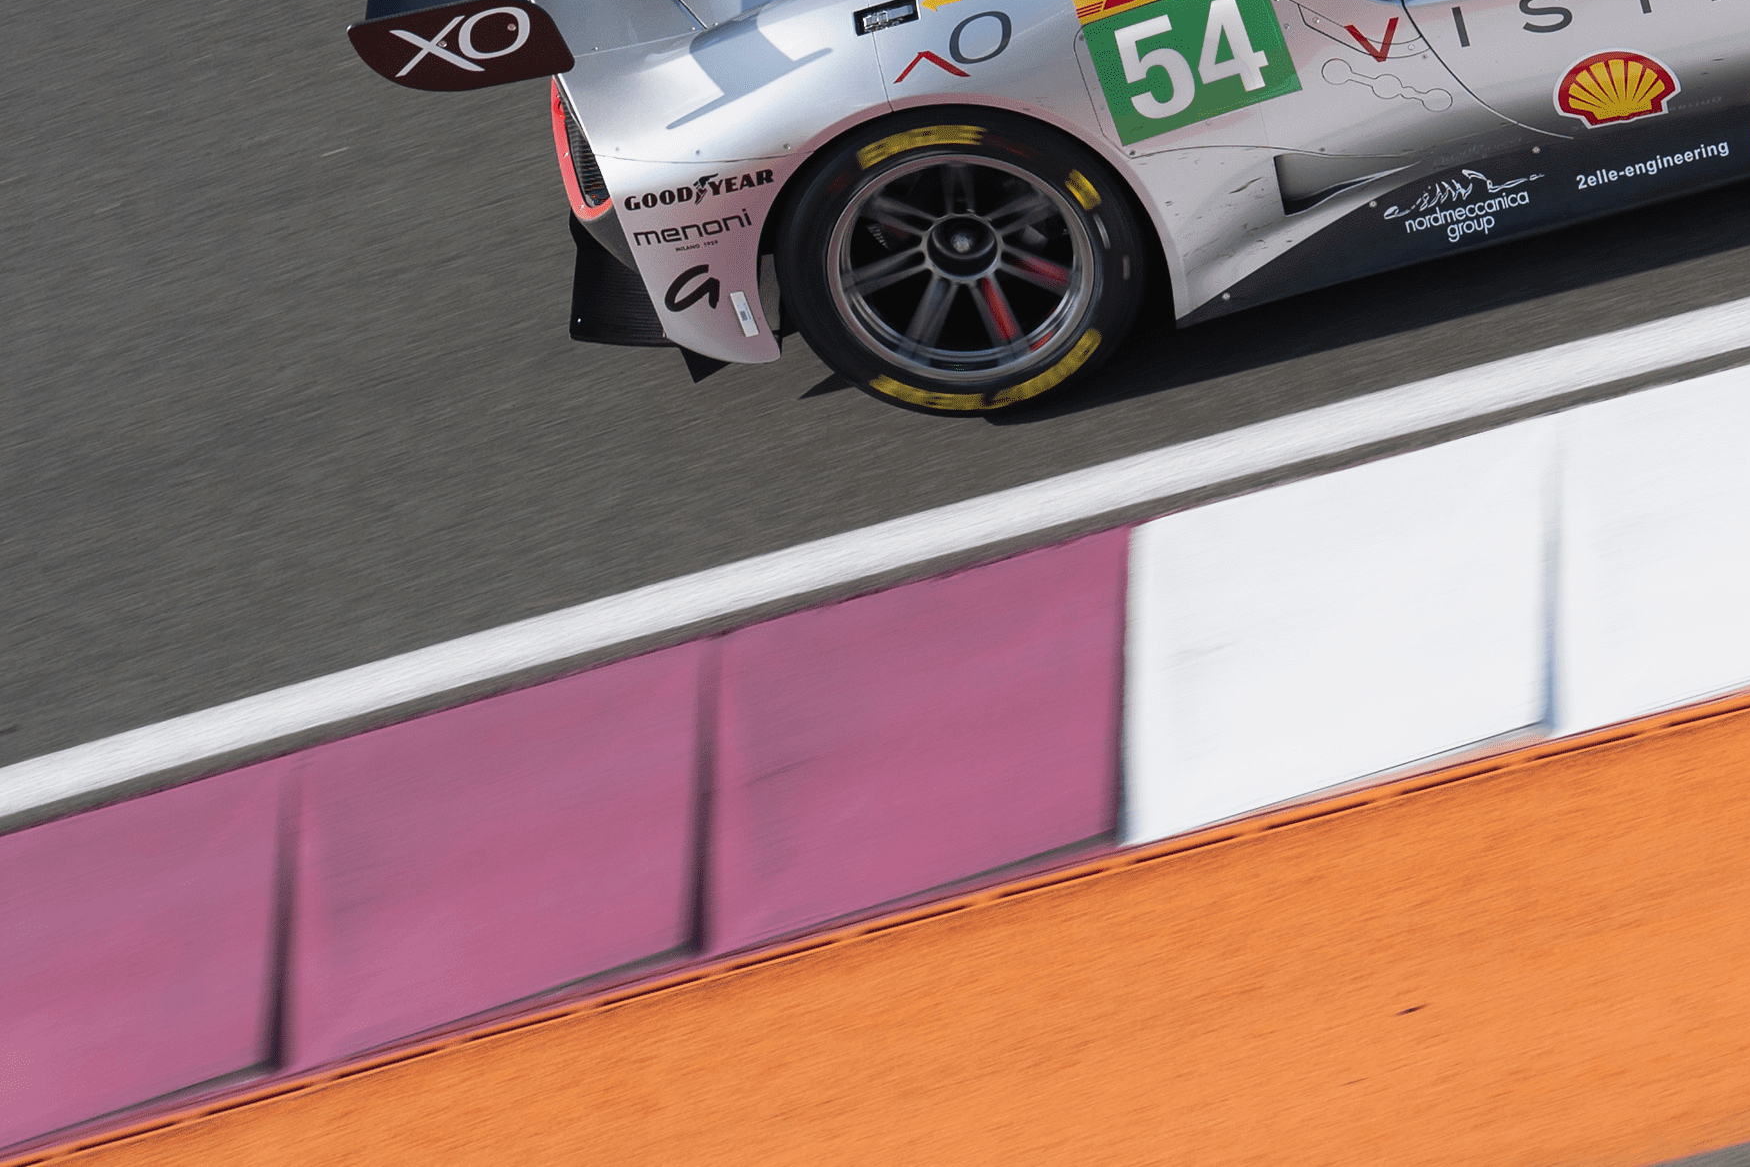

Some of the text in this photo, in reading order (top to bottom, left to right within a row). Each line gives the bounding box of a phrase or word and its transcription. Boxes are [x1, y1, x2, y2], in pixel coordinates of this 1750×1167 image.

[1575, 141, 1730, 191] 2elle-engineering
[624, 168, 775, 212] GOODYEAR
[1404, 190, 1530, 234] nordmeccanica
[632, 208, 753, 247] menoni
[1446, 215, 1496, 243] group
